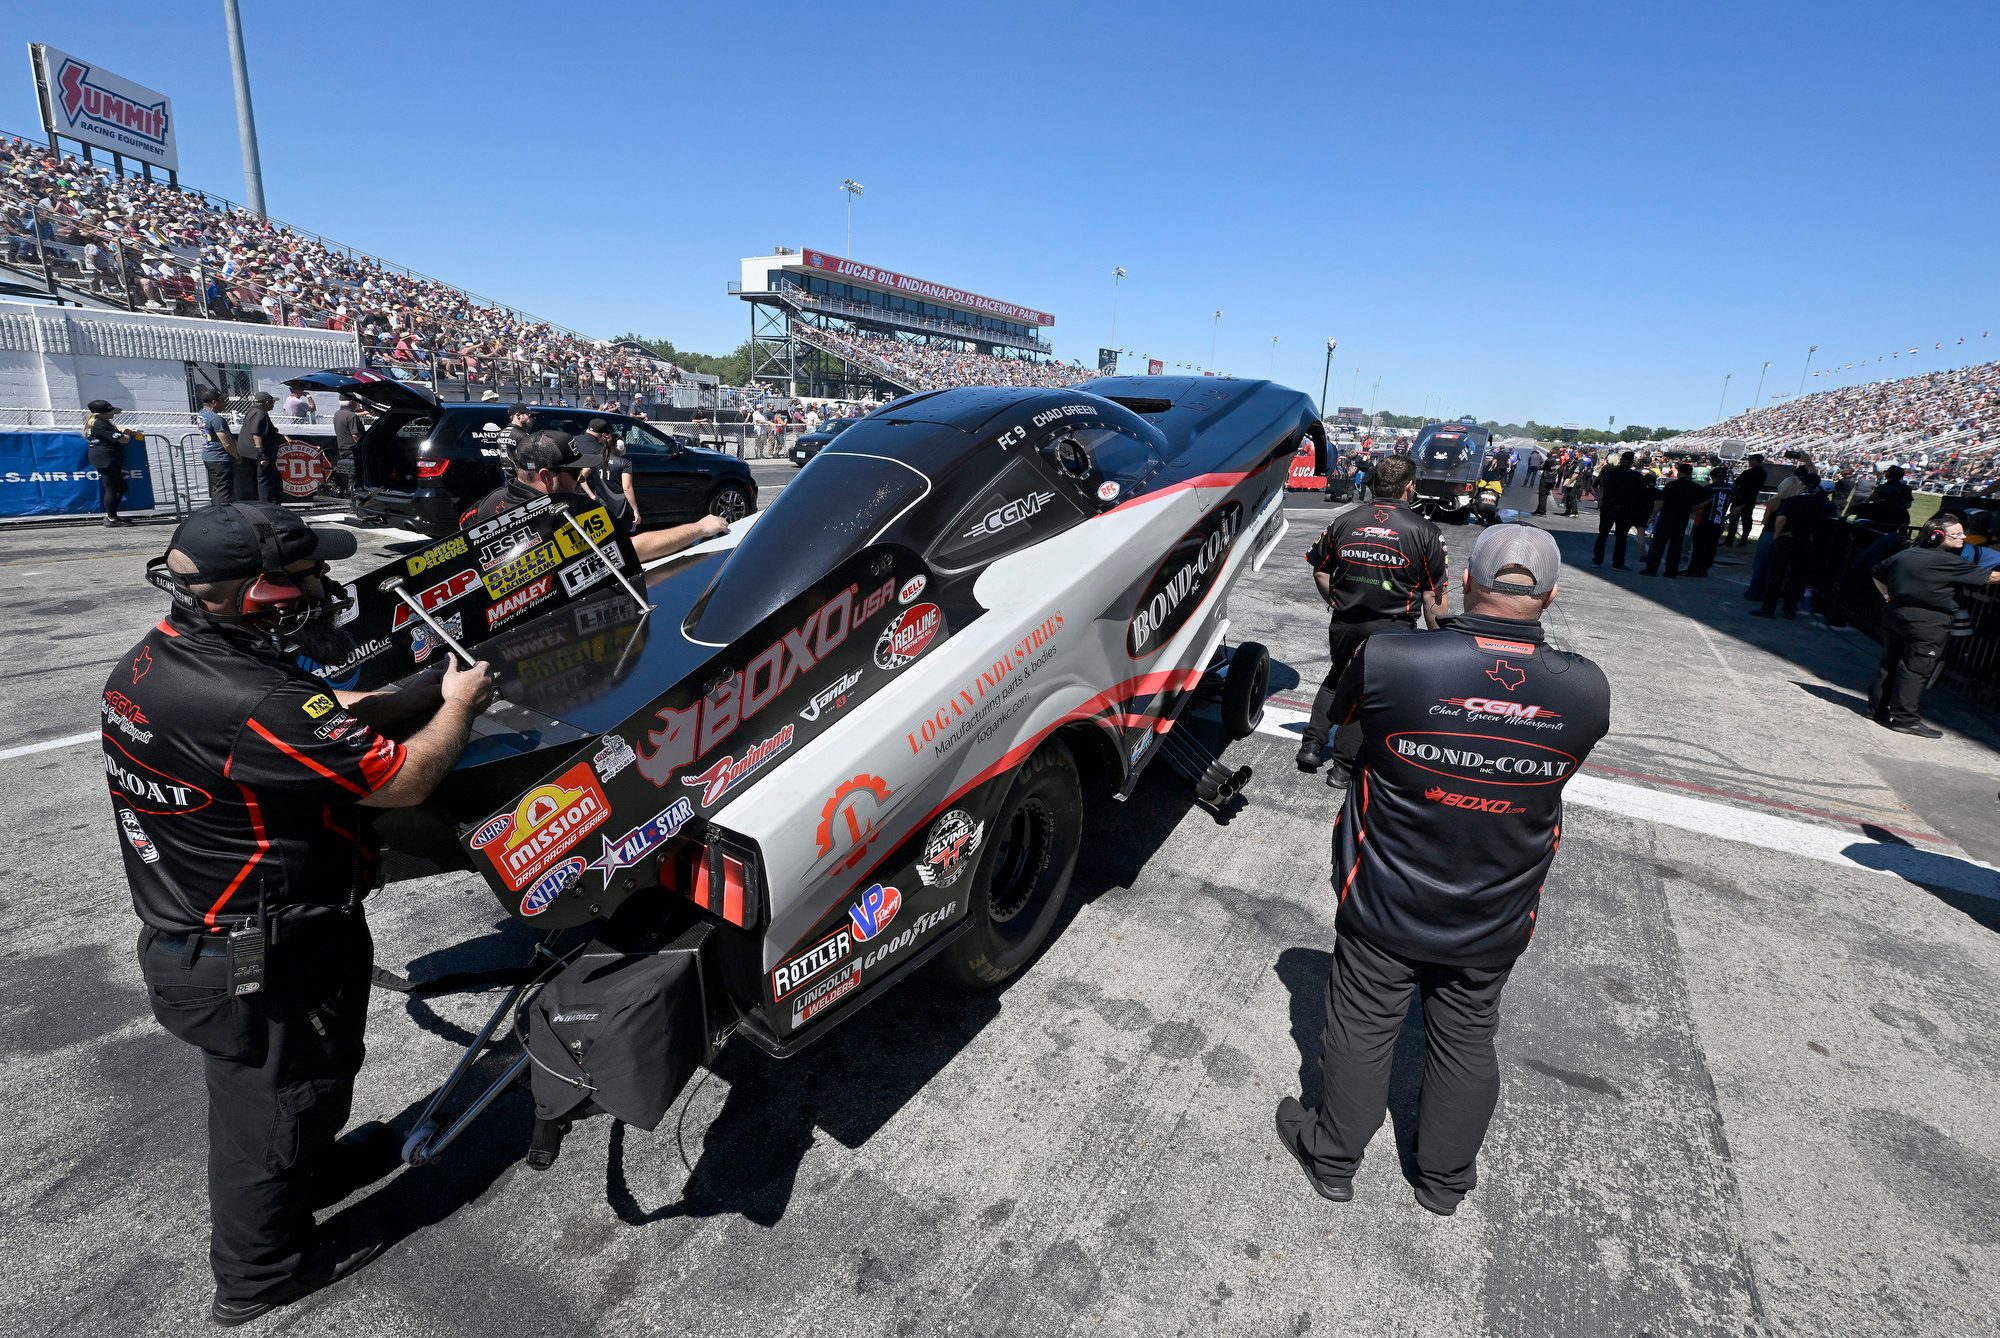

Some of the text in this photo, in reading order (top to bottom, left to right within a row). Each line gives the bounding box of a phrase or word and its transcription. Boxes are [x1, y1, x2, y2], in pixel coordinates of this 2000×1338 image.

[80, 121, 165, 157] RACING EQUIPMENT
[837, 260, 1040, 322] LUCAS OIL INDIANAPOLIS RACEWAY PARK
[1032, 404, 1099, 428] CHAD GREEN
[997, 425, 1027, 451] FC 9
[0, 469, 144, 483] .S. AIR FOCE
[275, 458, 324, 479] FDC
[1292, 466, 1318, 478] LUCA
[284, 484, 313, 492] COFFEE
[1101, 482, 1117, 497] RFC
[468, 494, 552, 540] QRS
[982, 491, 1042, 535] CGM
[1364, 526, 1392, 536] CGM
[473, 526, 508, 546] RACING
[478, 525, 542, 565] JESEL
[407, 536, 466, 577] DARTON
[426, 543, 469, 570] SLEEVES
[488, 543, 554, 592] BULLET
[1341, 549, 1405, 567] BOND-COAT
[499, 558, 556, 595] RACING CAMS
[901, 579, 924, 601] BELL
[1132, 505, 1241, 653] BOND-COAT
[394, 569, 478, 628] ARP
[487, 578, 547, 623] MANLEY
[489, 588, 558, 632] Powers the Winners
[378, 637, 391, 649] LLC
[895, 607, 937, 651] RED LINE
[901, 629, 932, 653] SYNTHETIC OIL
[697, 586, 854, 761] BOXO
[852, 576, 897, 630] USA
[905, 608, 1065, 758] LOGAN INDUSTRIES
[109, 690, 143, 724] CGM
[800, 668, 864, 722] Sander
[934, 643, 1057, 759] Manufacturing parts & bodies
[1463, 697, 1541, 719] CGM
[976, 692, 1030, 745] logankc.com
[1428, 704, 1566, 731] Chad Green Motorsports
[1397, 738, 1571, 777] BOND-COAT
[1479, 767, 1494, 775] INC.
[103, 752, 192, 806] ND-COAT
[1440, 793, 1527, 814] BOXO USA
[476, 818, 510, 845] NHRA
[515, 807, 609, 888] DRAG RACING SERIES
[624, 800, 693, 862] ALL STAR
[929, 823, 970, 859] FLYING
[527, 859, 572, 897] CHAMPIONSHIP
[848, 883, 885, 941] VP
[877, 894, 899, 928] Racing
[864, 900, 957, 970] GOODYEAR
[774, 931, 850, 997] ROTTLER
[796, 966, 852, 1013] LINCOLN
[808, 978, 855, 1016] WELDERS
[563, 1013, 598, 1023] IMPACT
